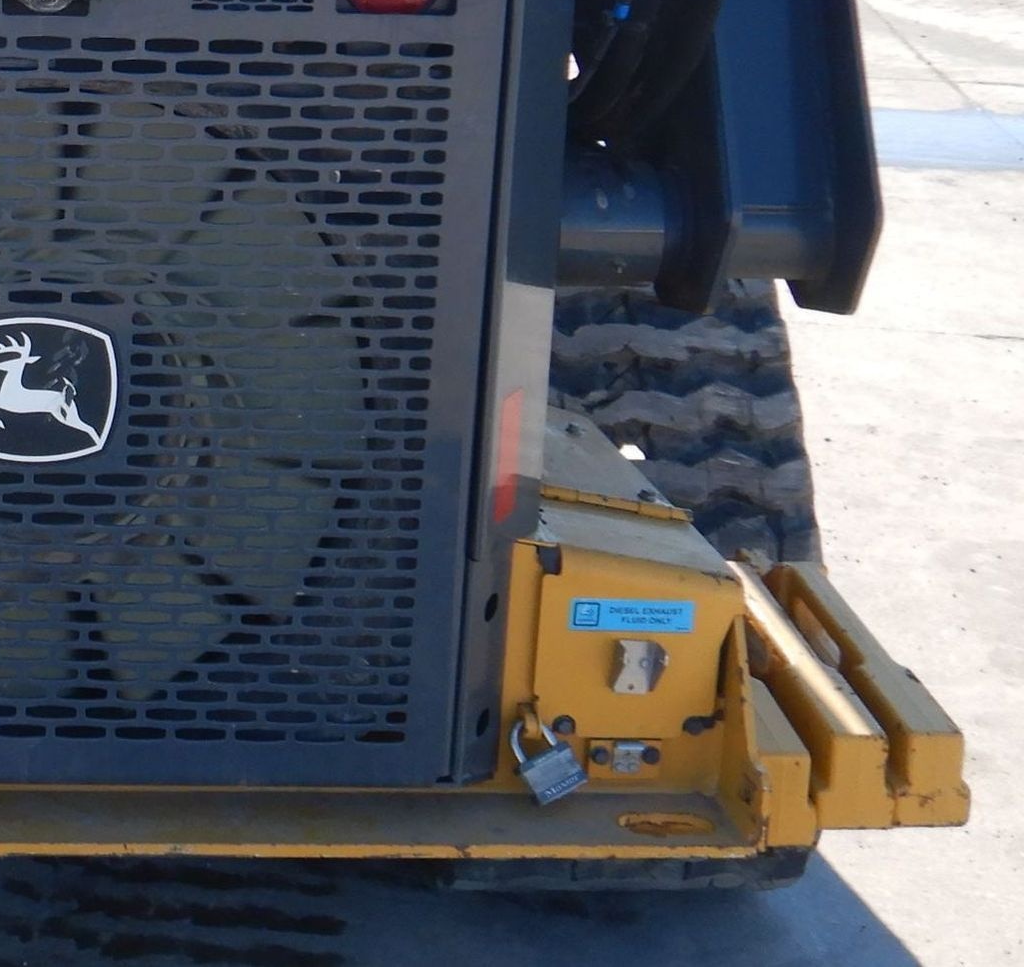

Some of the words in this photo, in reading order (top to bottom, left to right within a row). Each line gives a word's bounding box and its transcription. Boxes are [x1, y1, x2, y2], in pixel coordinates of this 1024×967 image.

[608, 606, 639, 615] DIESEL
[642, 607, 683, 616] EXHAUST
[621, 616, 647, 624] FLUID
[649, 616, 671, 624] ONLY
